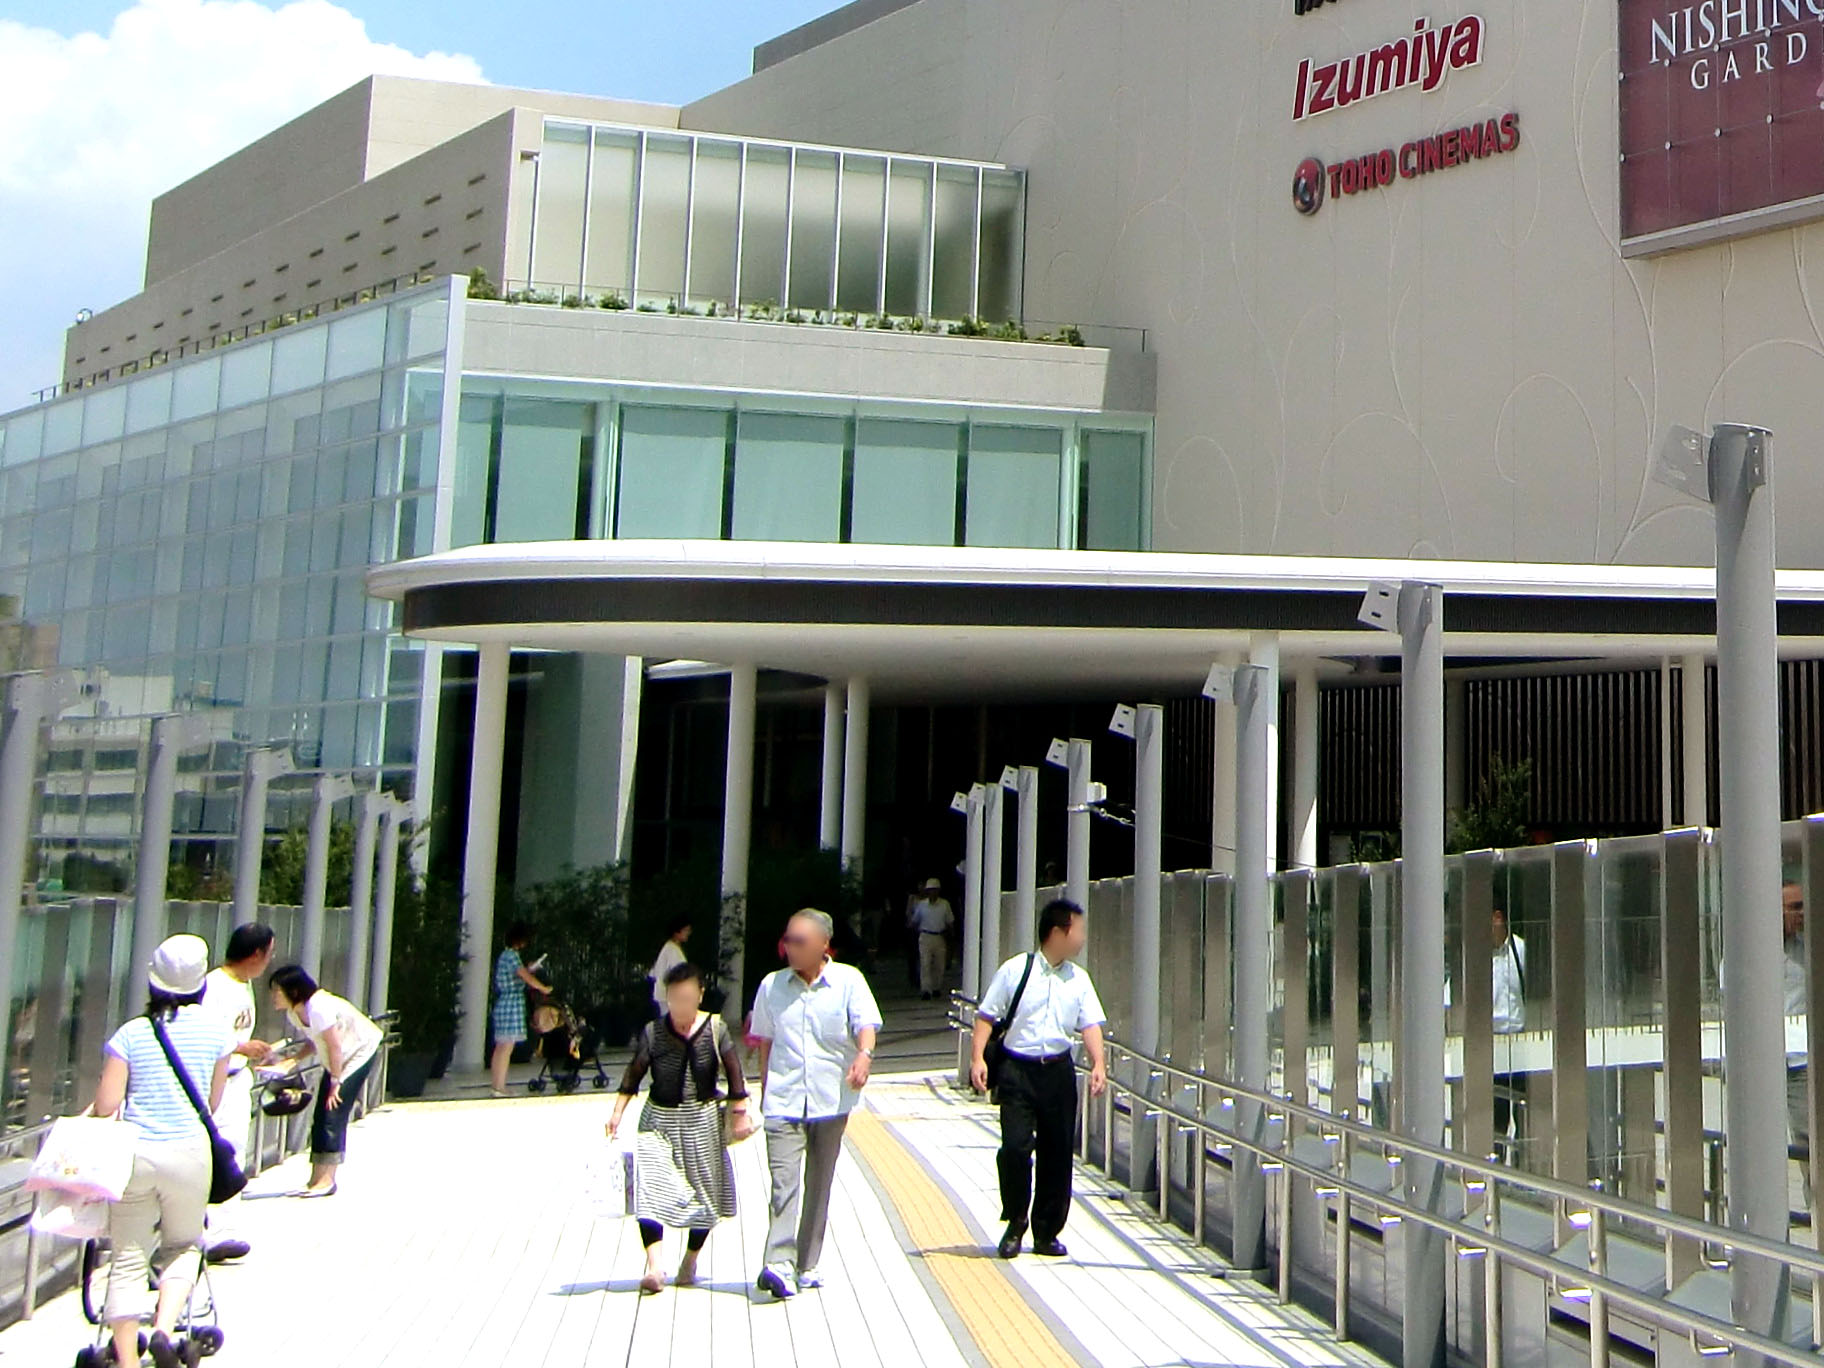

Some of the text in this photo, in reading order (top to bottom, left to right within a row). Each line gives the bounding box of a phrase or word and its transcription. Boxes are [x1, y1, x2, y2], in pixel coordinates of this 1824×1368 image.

[1292, 14, 1486, 121] Izumiya
[1326, 113, 1521, 199] TOHO CINEMAS
